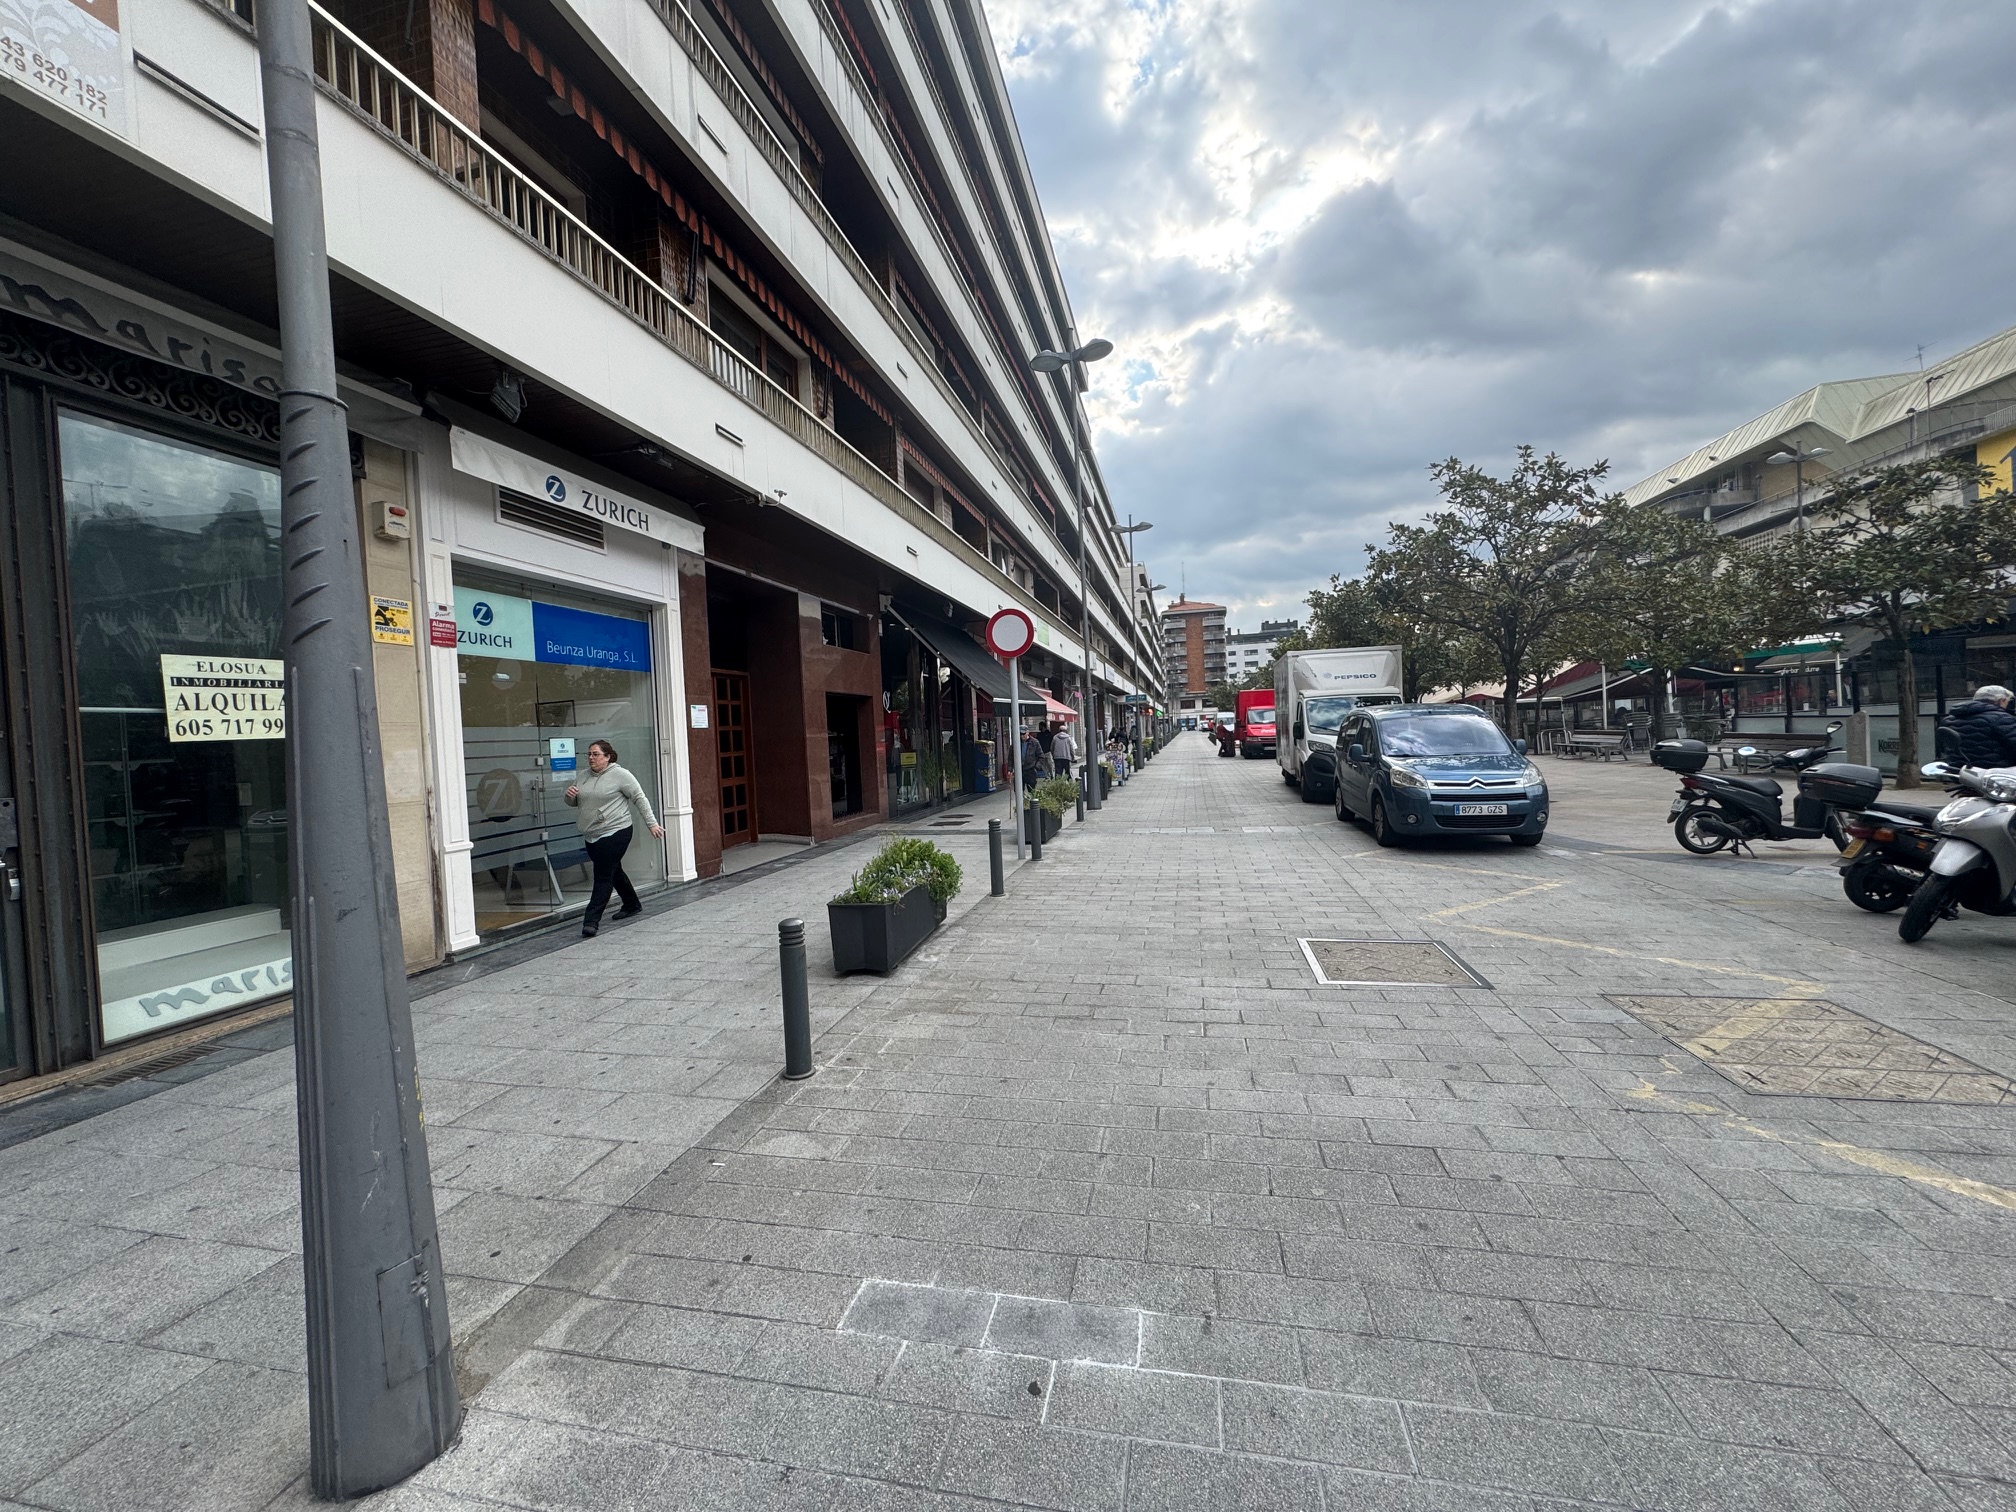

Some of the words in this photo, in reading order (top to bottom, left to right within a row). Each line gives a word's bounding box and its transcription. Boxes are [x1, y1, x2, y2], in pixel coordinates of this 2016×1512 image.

[32, 53, 68, 82] 620
[75, 78, 108, 106] 182
[33, 70, 68, 96] 477
[76, 93, 107, 119] 171
[582, 489, 649, 532] ZURICH
[375, 625, 411, 636] PROSEGUR
[432, 620, 455, 630] Alarma
[457, 630, 513, 649] ZURICH
[547, 640, 584, 657] Beunza
[586, 646, 622, 664] Uranga,
[624, 651, 638, 664] S.L.
[196, 661, 268, 675] ELOSUA
[172, 677, 285, 689] INMOBILIARI
[175, 718, 214, 737] 605
[221, 718, 255, 735] 717
[1461, 805, 1483, 814] 8773
[1487, 805, 1504, 814] GZS
